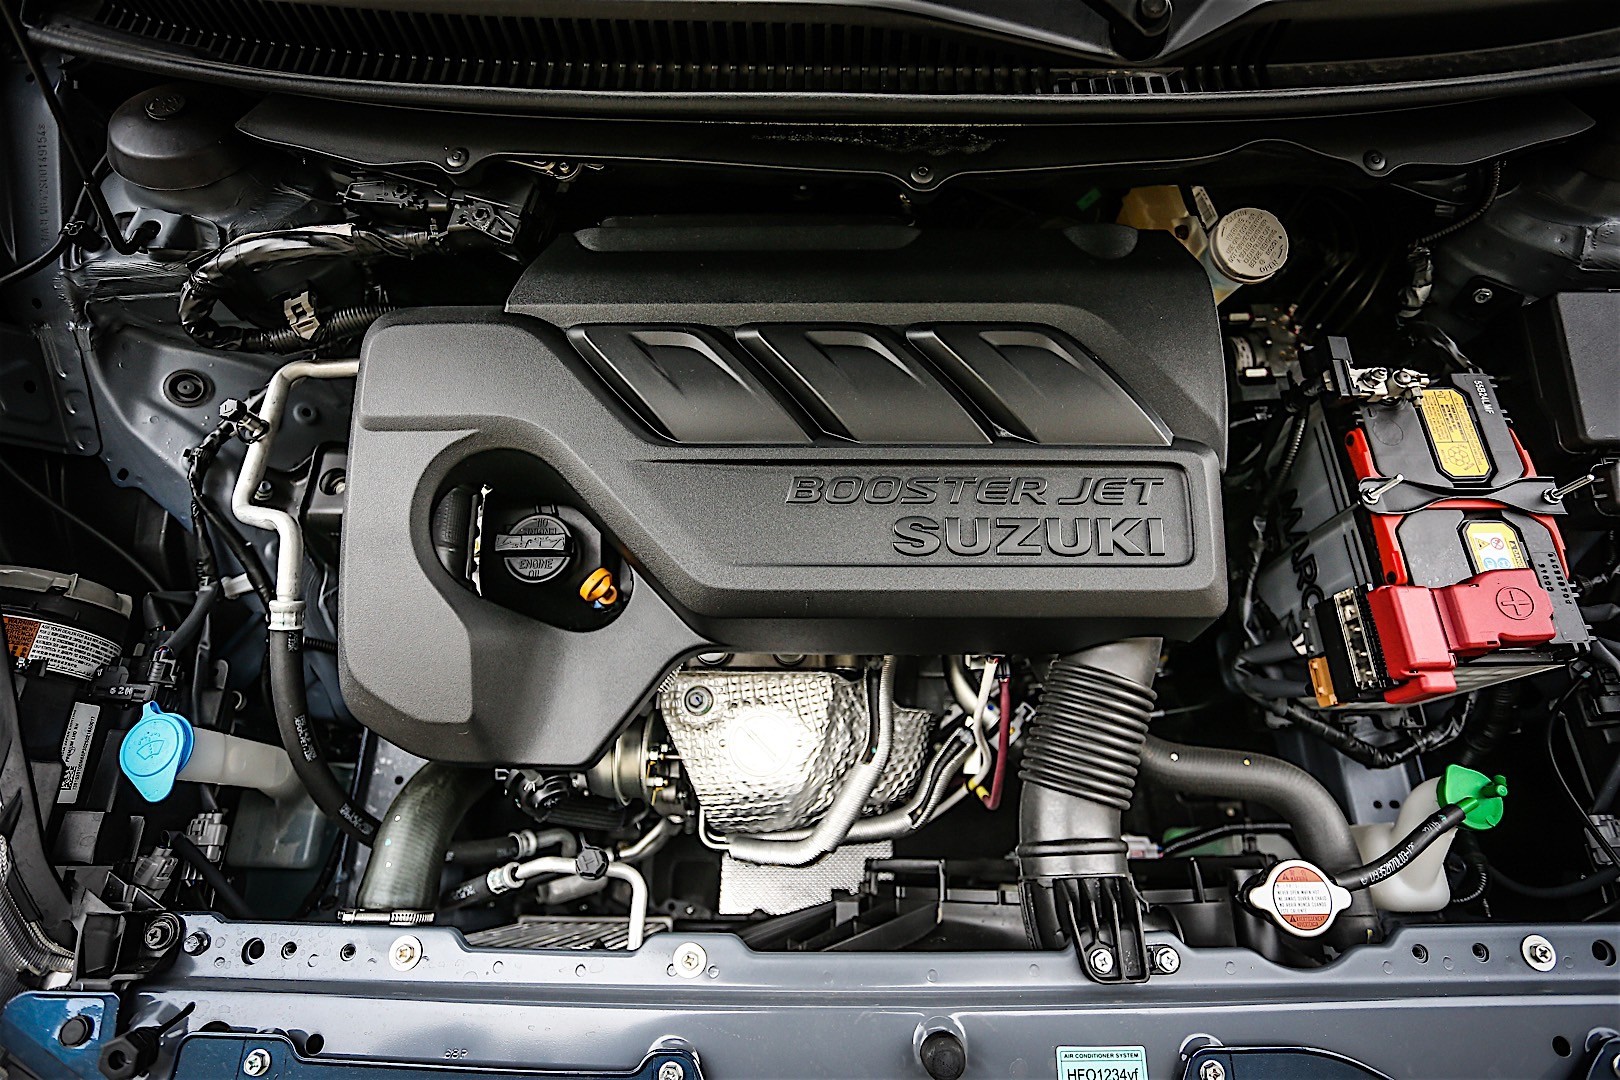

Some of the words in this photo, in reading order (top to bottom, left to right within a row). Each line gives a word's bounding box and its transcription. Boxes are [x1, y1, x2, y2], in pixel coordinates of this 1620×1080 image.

[787, 476, 1048, 505] BOOSTER
[1058, 477, 1165, 505] JET
[893, 515, 1166, 556] SUZUKI
